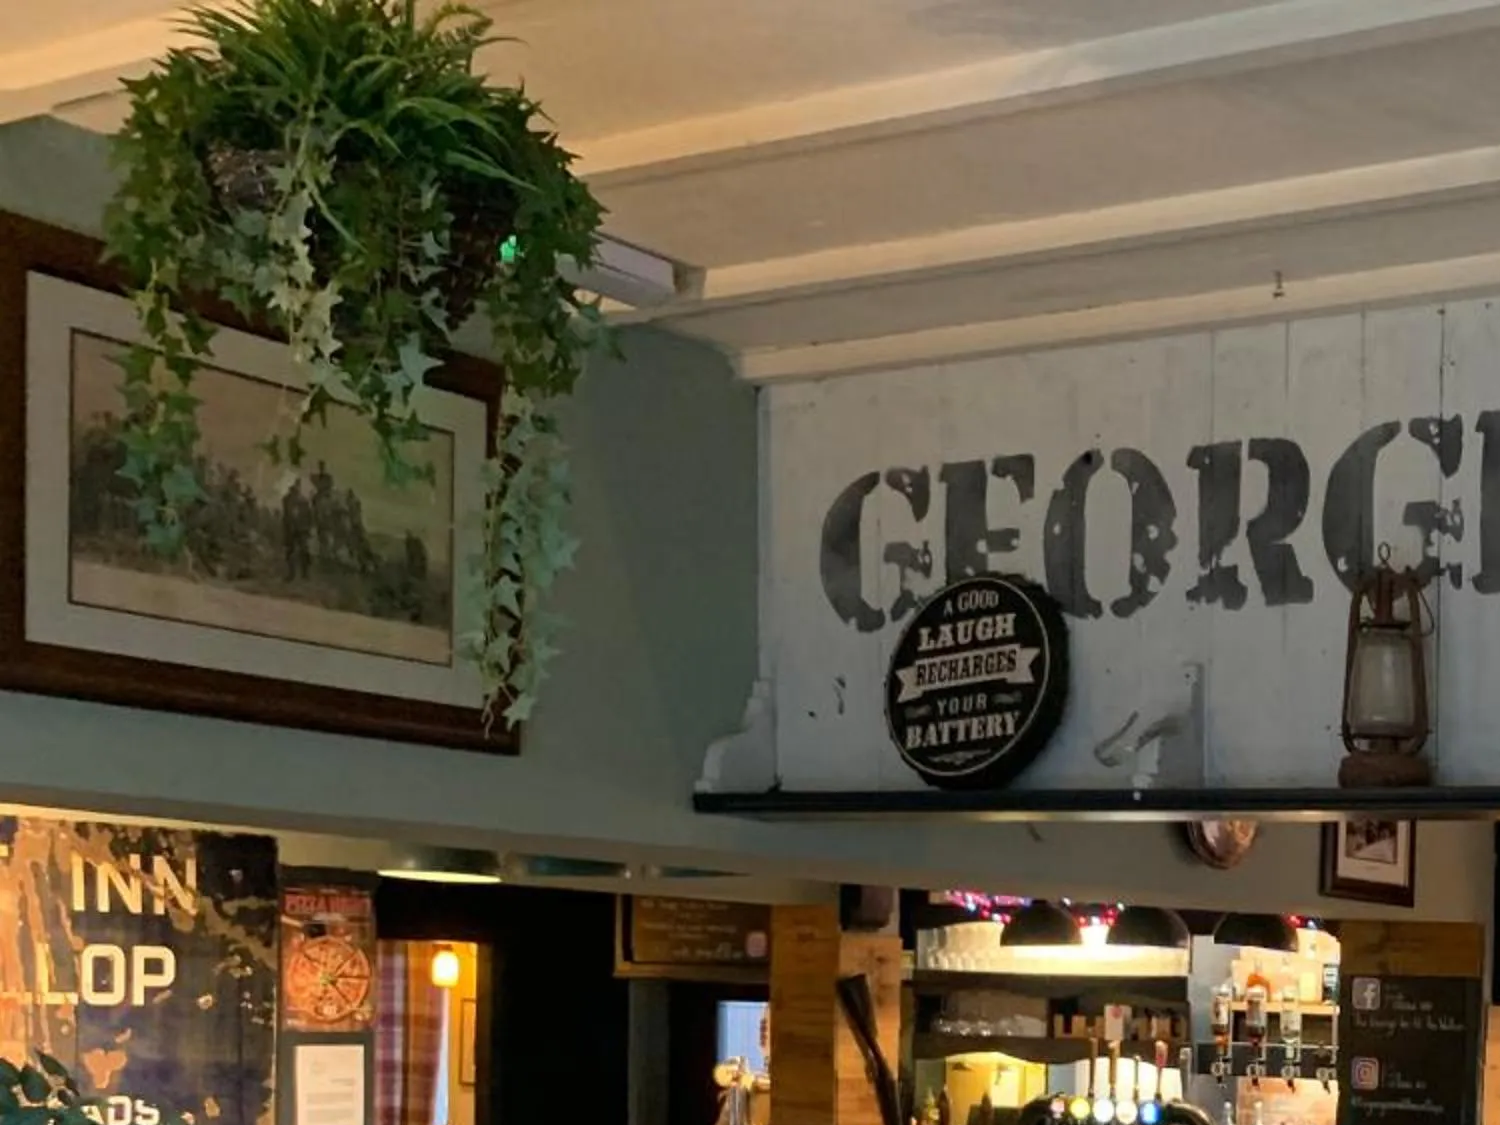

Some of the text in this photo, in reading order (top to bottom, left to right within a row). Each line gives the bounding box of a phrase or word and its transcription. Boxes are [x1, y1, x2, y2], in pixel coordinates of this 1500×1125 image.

[943, 589, 999, 617] A GOOD
[916, 613, 1017, 651] LAUGH
[916, 648, 1018, 686] RECHARGES
[936, 693, 988, 716] YOUR
[904, 710, 1021, 750] BATTERY
[70, 850, 197, 916] INN
